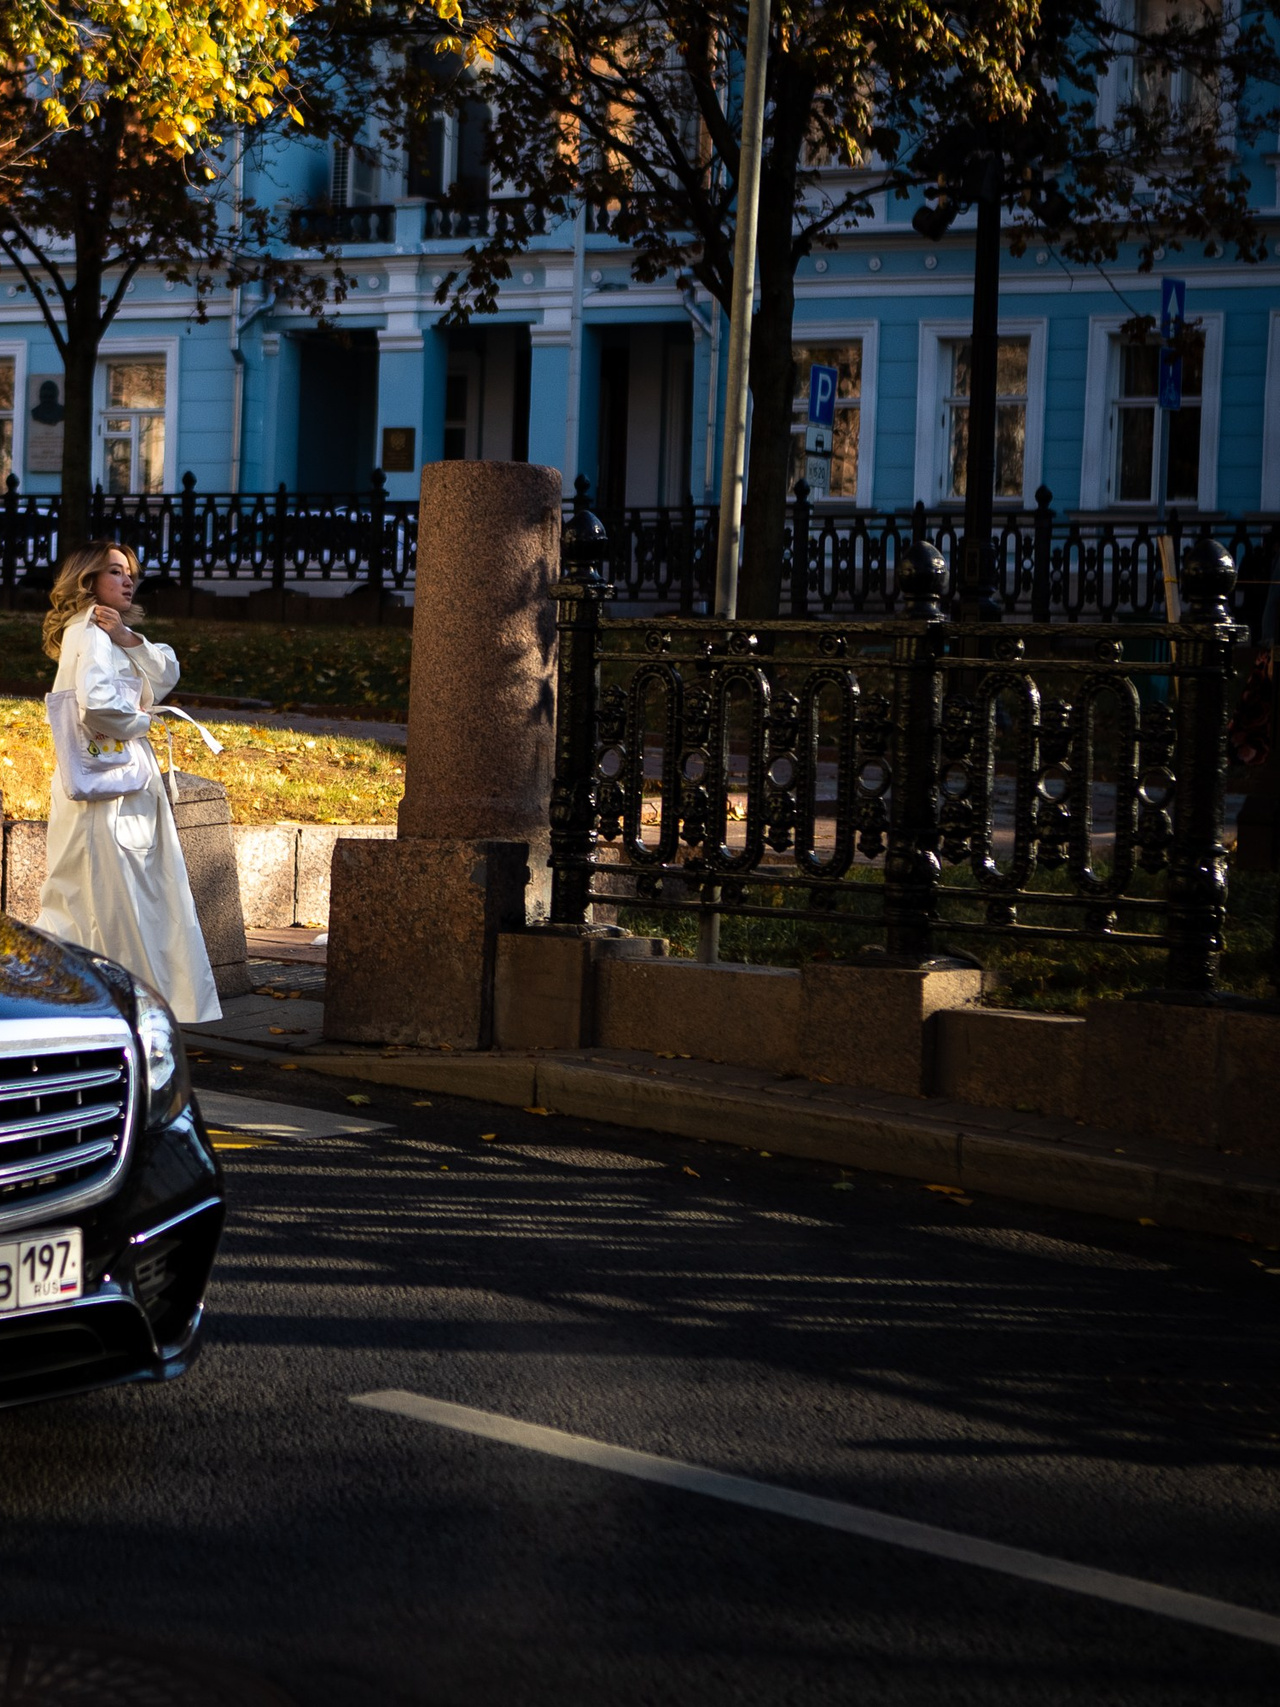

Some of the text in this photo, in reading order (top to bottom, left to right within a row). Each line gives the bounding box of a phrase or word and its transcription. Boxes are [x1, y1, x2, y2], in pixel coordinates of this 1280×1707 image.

[816, 373, 832, 417] P
[22, 1241, 70, 1283] 197
[33, 1281, 60, 1296] RUS
